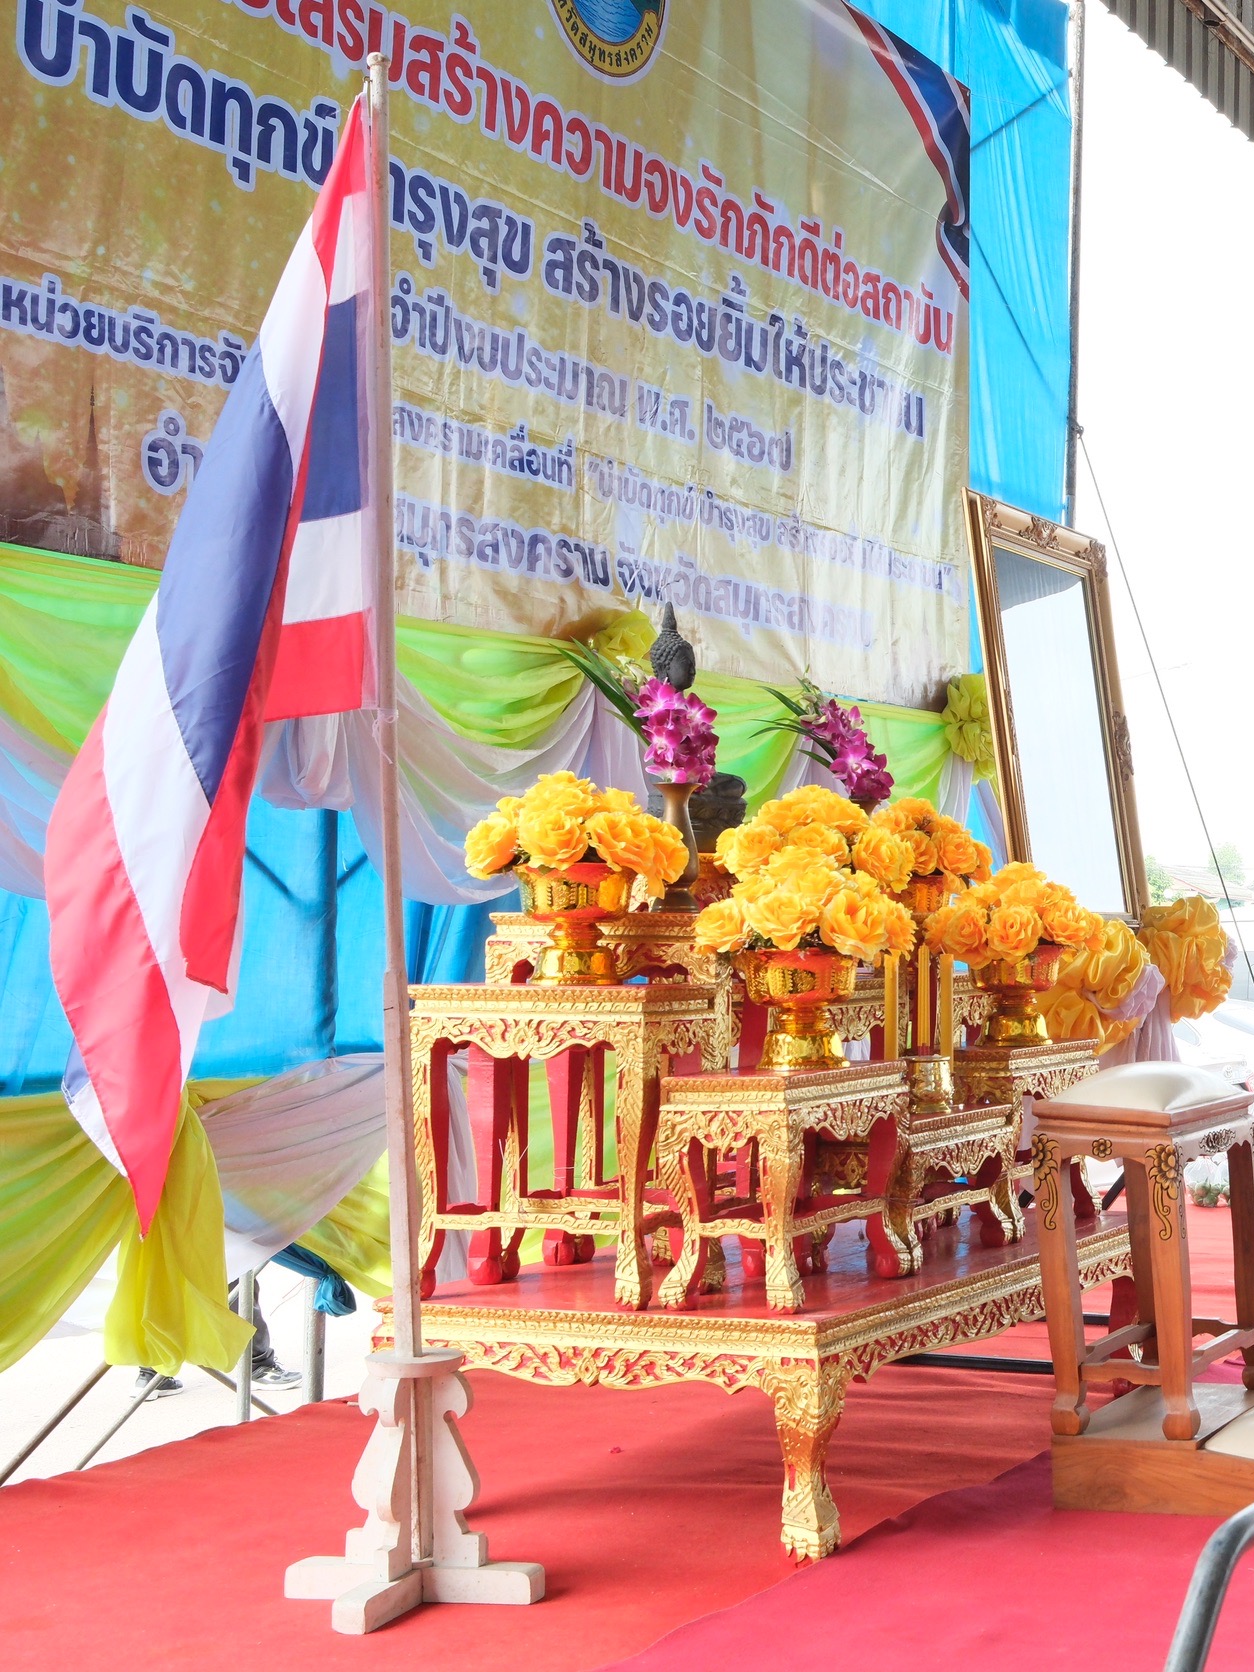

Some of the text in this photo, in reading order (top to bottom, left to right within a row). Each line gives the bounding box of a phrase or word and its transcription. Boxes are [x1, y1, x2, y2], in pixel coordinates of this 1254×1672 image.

[2, 280, 247, 384] หน่วยบริการจั
[637, 385, 697, 442] พ.ศ.
[706, 403, 792, 472] ๒๕๖๗
